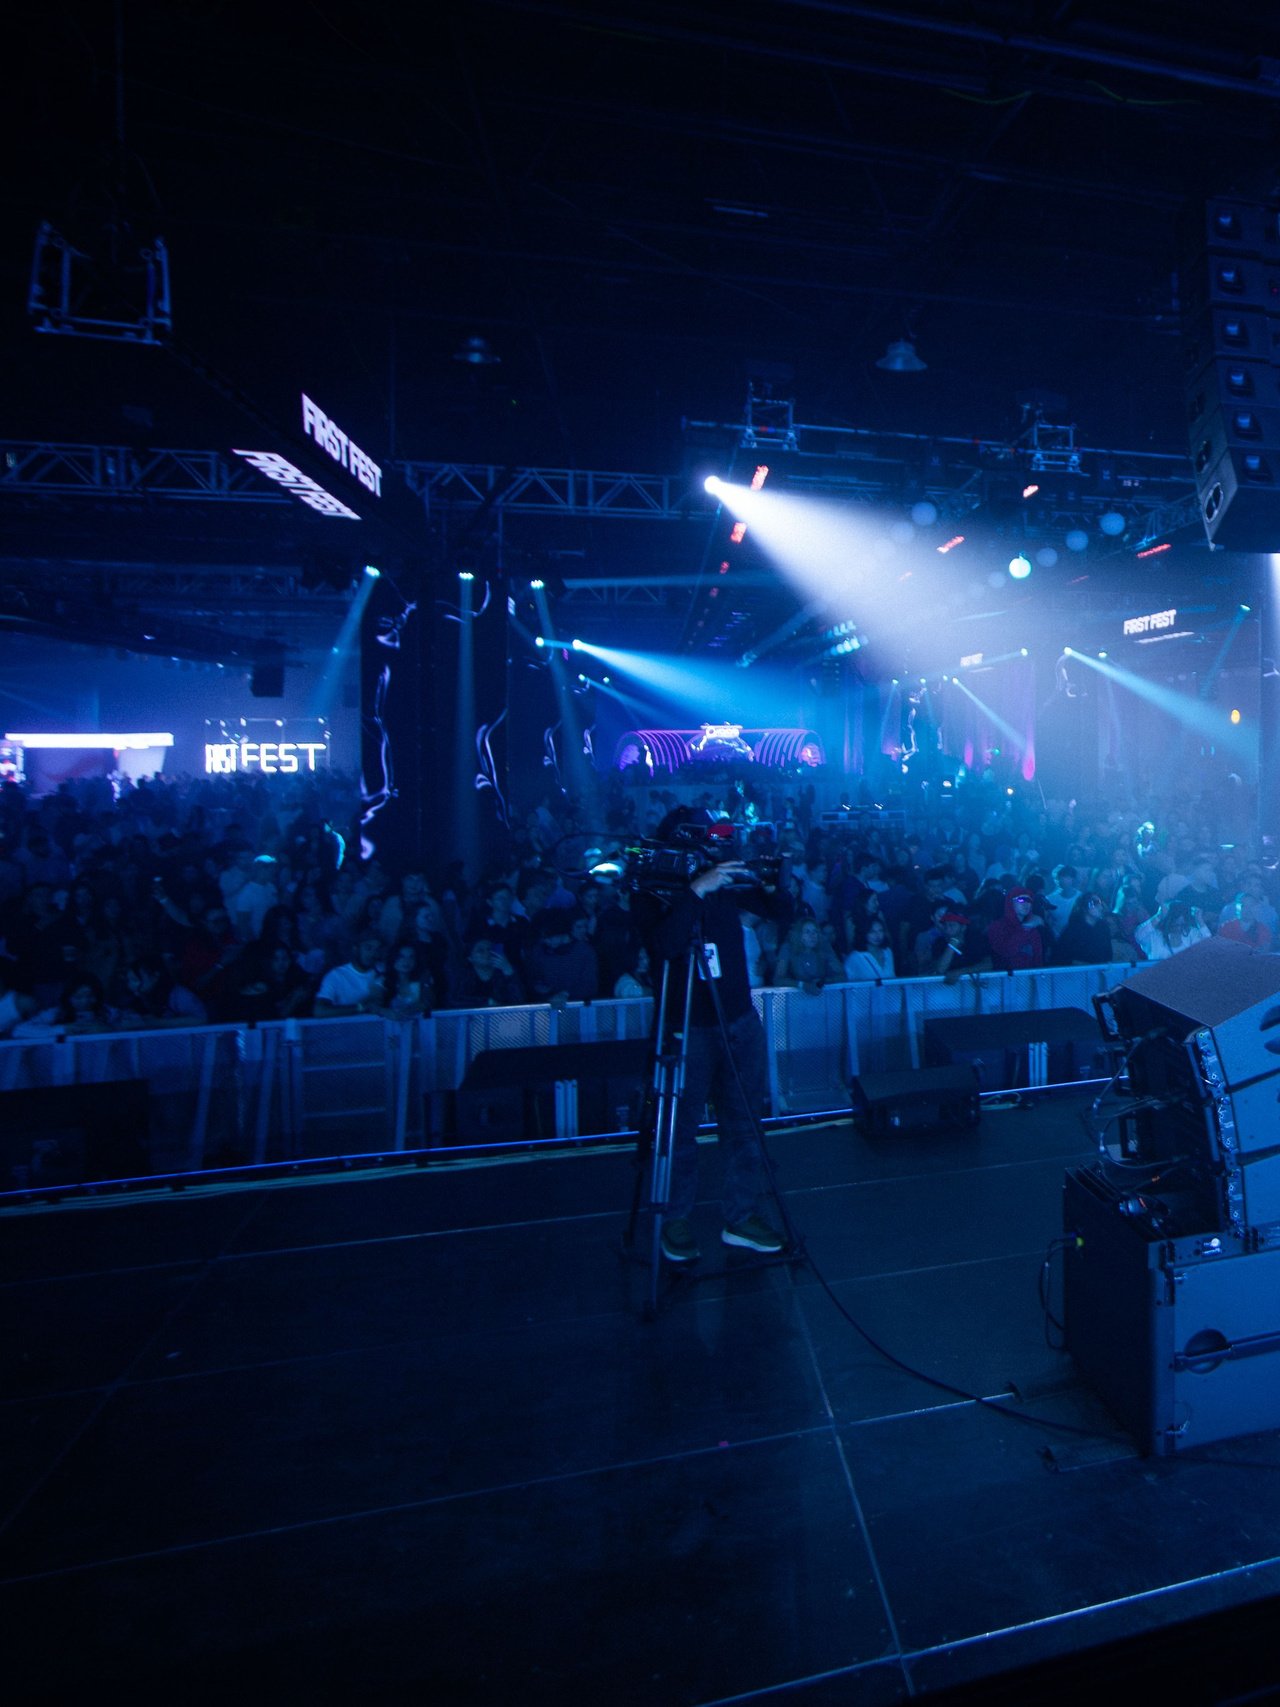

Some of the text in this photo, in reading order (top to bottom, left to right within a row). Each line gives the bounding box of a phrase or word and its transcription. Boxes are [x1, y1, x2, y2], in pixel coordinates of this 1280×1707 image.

[302, 392, 383, 498] FIRST FEST
[1123, 609, 1177, 635] FIRST FEST
[241, 743, 327, 773] FEST
